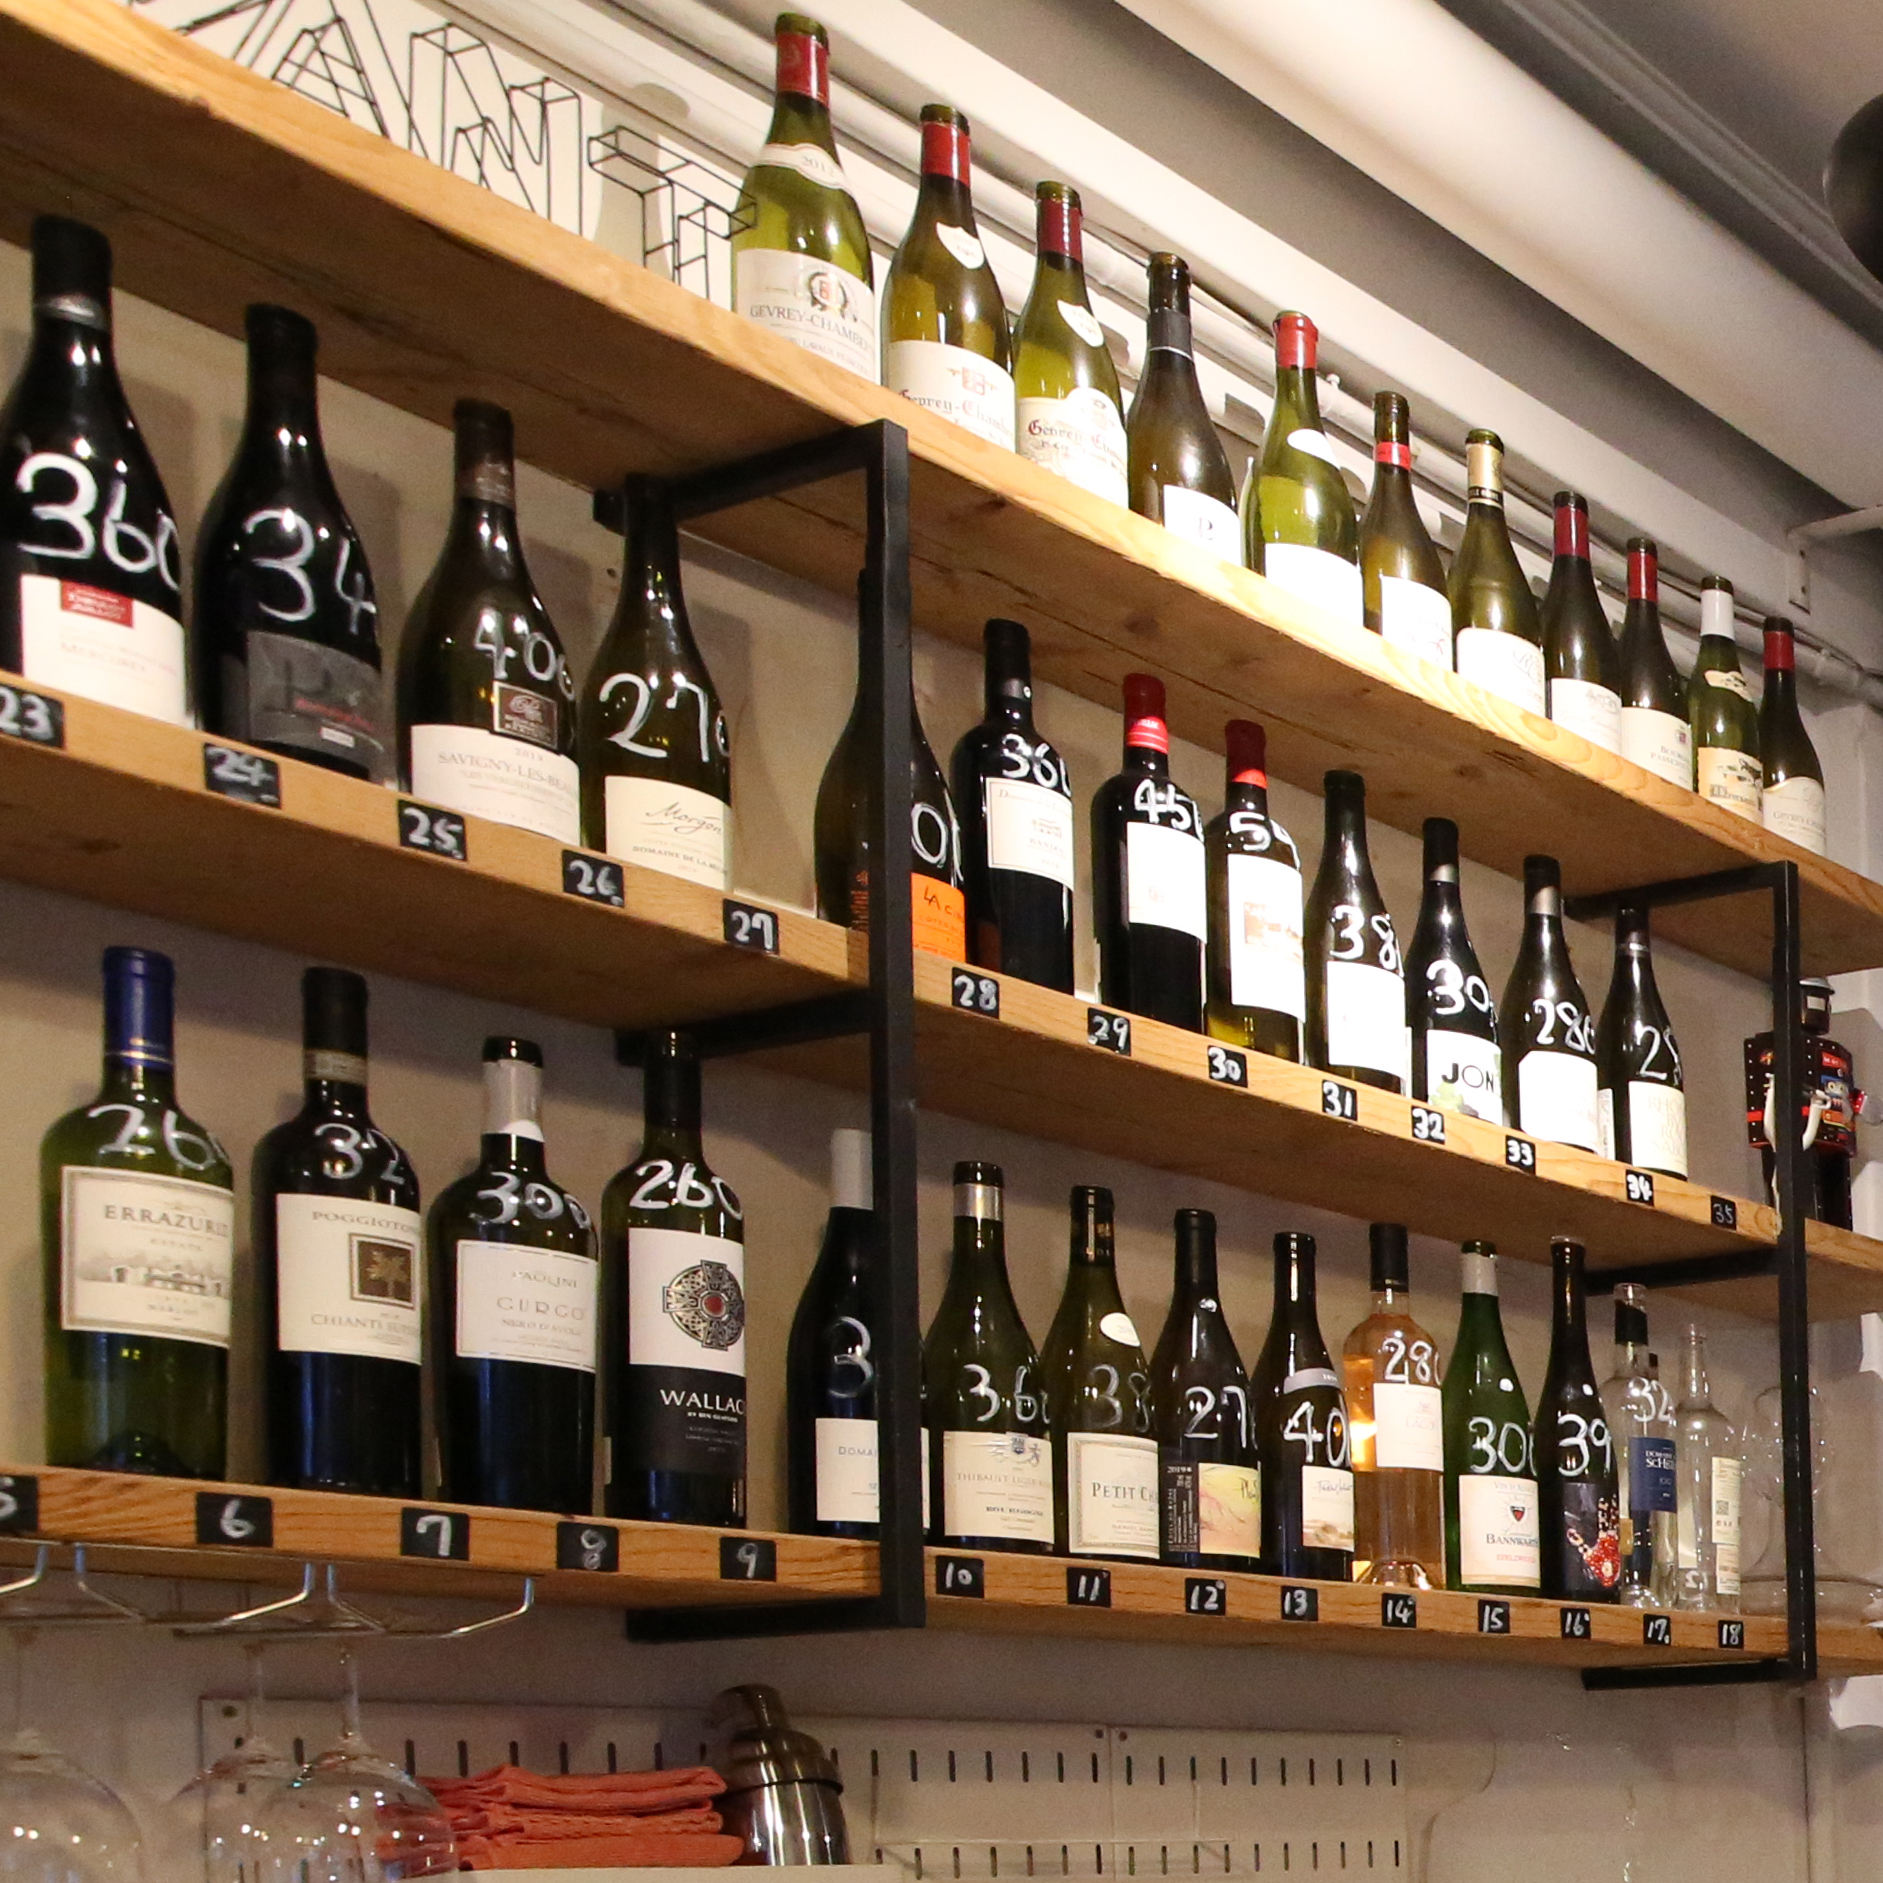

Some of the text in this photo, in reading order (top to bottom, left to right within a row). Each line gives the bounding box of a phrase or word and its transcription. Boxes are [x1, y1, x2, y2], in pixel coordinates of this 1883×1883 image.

[209, 748, 274, 788] 24
[403, 806, 463, 850] 25
[730, 910, 774, 951] 27
[954, 975, 998, 1011] 28
[1090, 1016, 1128, 1051] 29
[1209, 1046, 1243, 1084] 30
[1324, 1083, 1354, 1119] 31
[1413, 1106, 1445, 1141] 32
[1506, 1139, 1534, 1168] 33
[1626, 1173, 1653, 1201] 34
[1712, 1202, 1735, 1226] 35
[1092, 1482, 1135, 1501] PETIT
[220, 1499, 256, 1539] 6
[415, 1513, 452, 1557] 7
[580, 1529, 607, 1571] 8
[737, 1542, 758, 1579] 9
[944, 1562, 973, 1588] 10
[1077, 1574, 1101, 1603] 11
[1190, 1583, 1220, 1612] 12
[1283, 1589, 1311, 1615] 13
[1387, 1598, 1413, 1627] 14
[1483, 1605, 1506, 1632] 15
[1565, 1609, 1587, 1637] 16
[1721, 1623, 1742, 1646] 18
